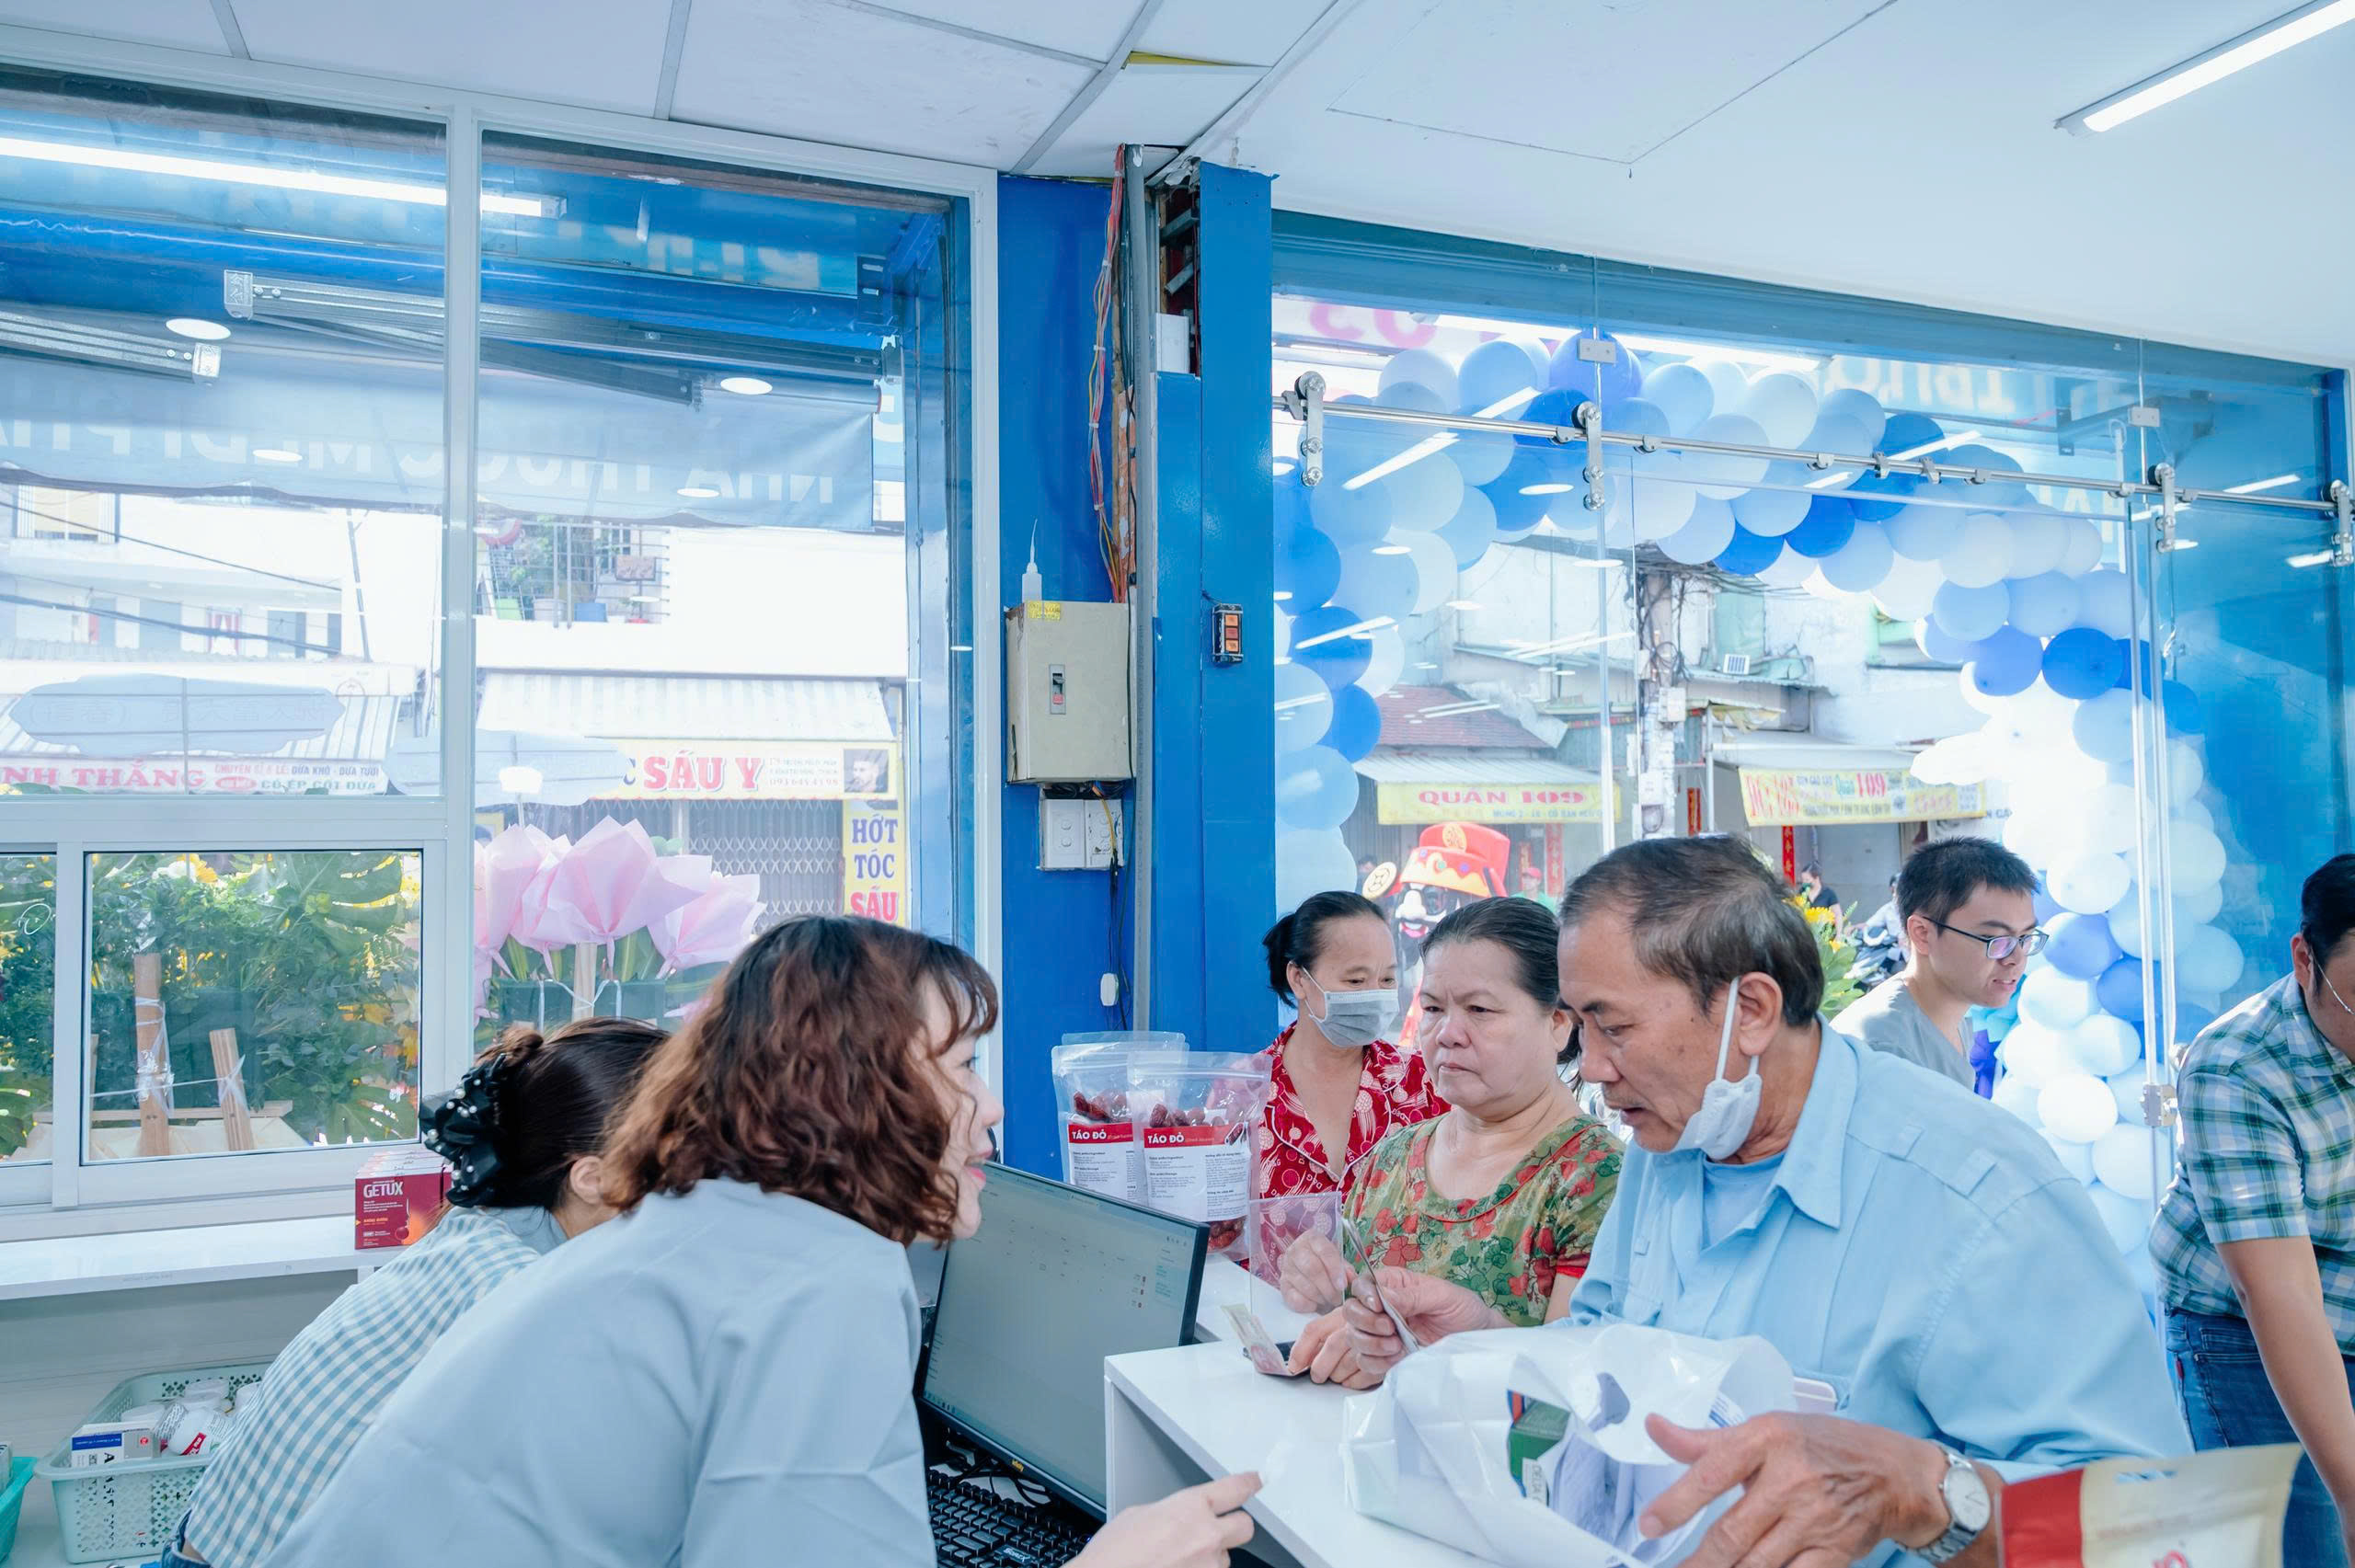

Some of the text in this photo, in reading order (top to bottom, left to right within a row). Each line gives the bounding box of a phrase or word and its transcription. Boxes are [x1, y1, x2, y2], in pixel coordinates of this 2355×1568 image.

[72, 759, 207, 788] THẮNG
[735, 756, 764, 791] Y
[1522, 791, 1586, 804] 109
[851, 812, 899, 844] HỚT
[854, 848, 895, 879] TÓC
[1071, 1128, 1090, 1139] TÁO
[1147, 1132, 1167, 1144] TÁO
[362, 1181, 404, 1198] GETUX
